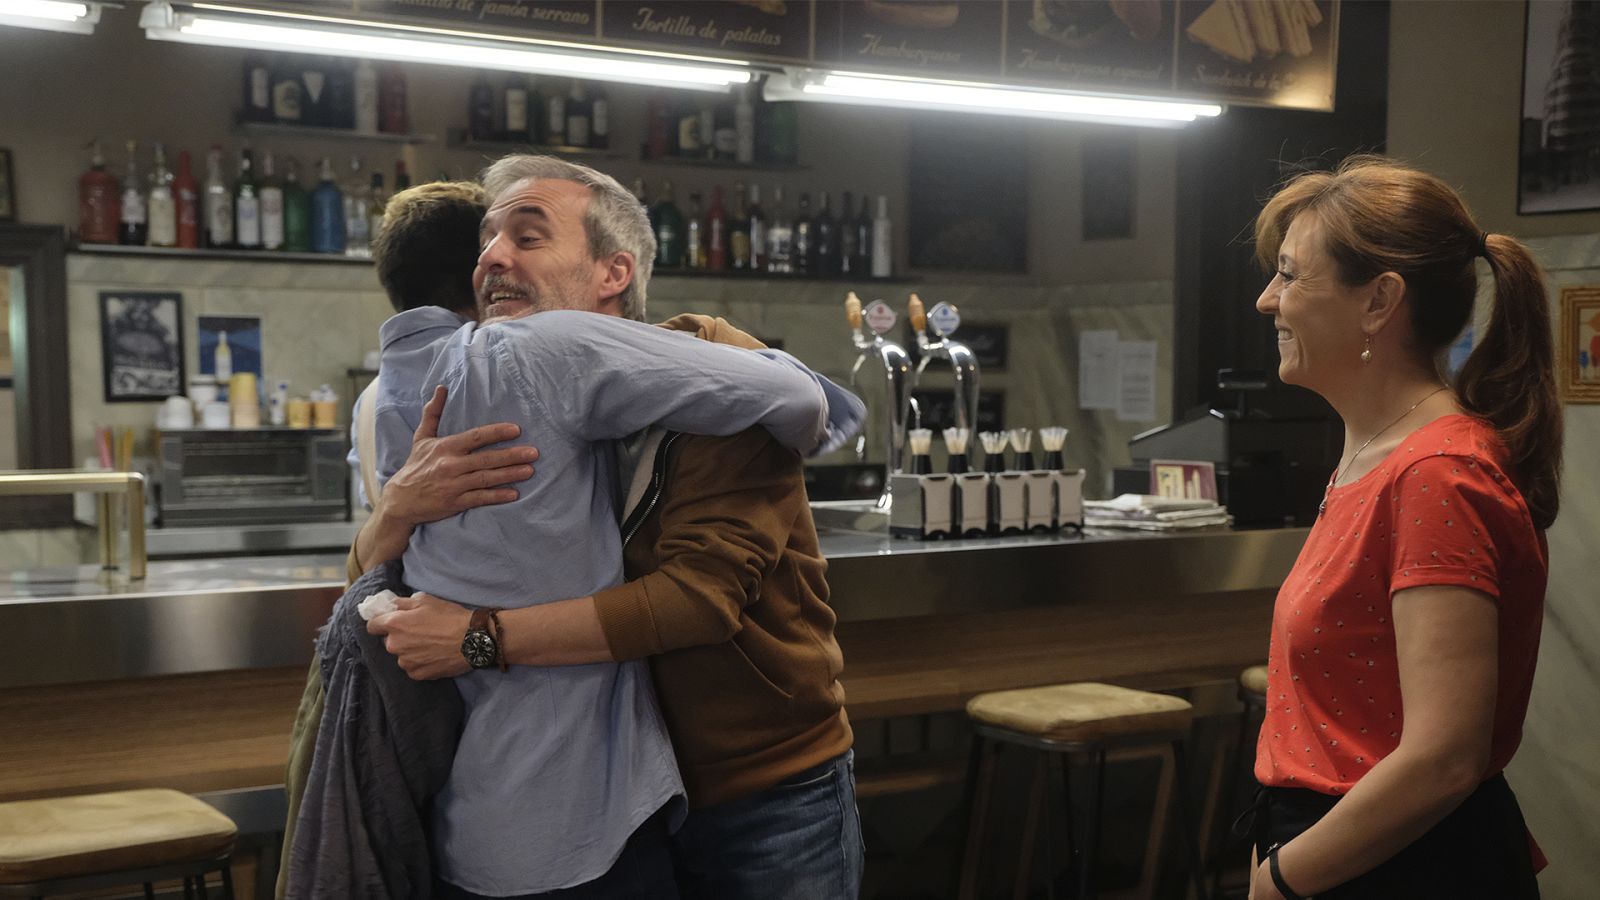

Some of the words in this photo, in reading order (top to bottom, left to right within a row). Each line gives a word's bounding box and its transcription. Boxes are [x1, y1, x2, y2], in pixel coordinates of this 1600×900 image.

[457, 0, 475, 12] de
[477, 0, 529, 20] jamón
[532, 6, 591, 25] serrano
[632, 6, 696, 37] Tortilla
[699, 19, 718, 40] de
[720, 25, 783, 48] patatas
